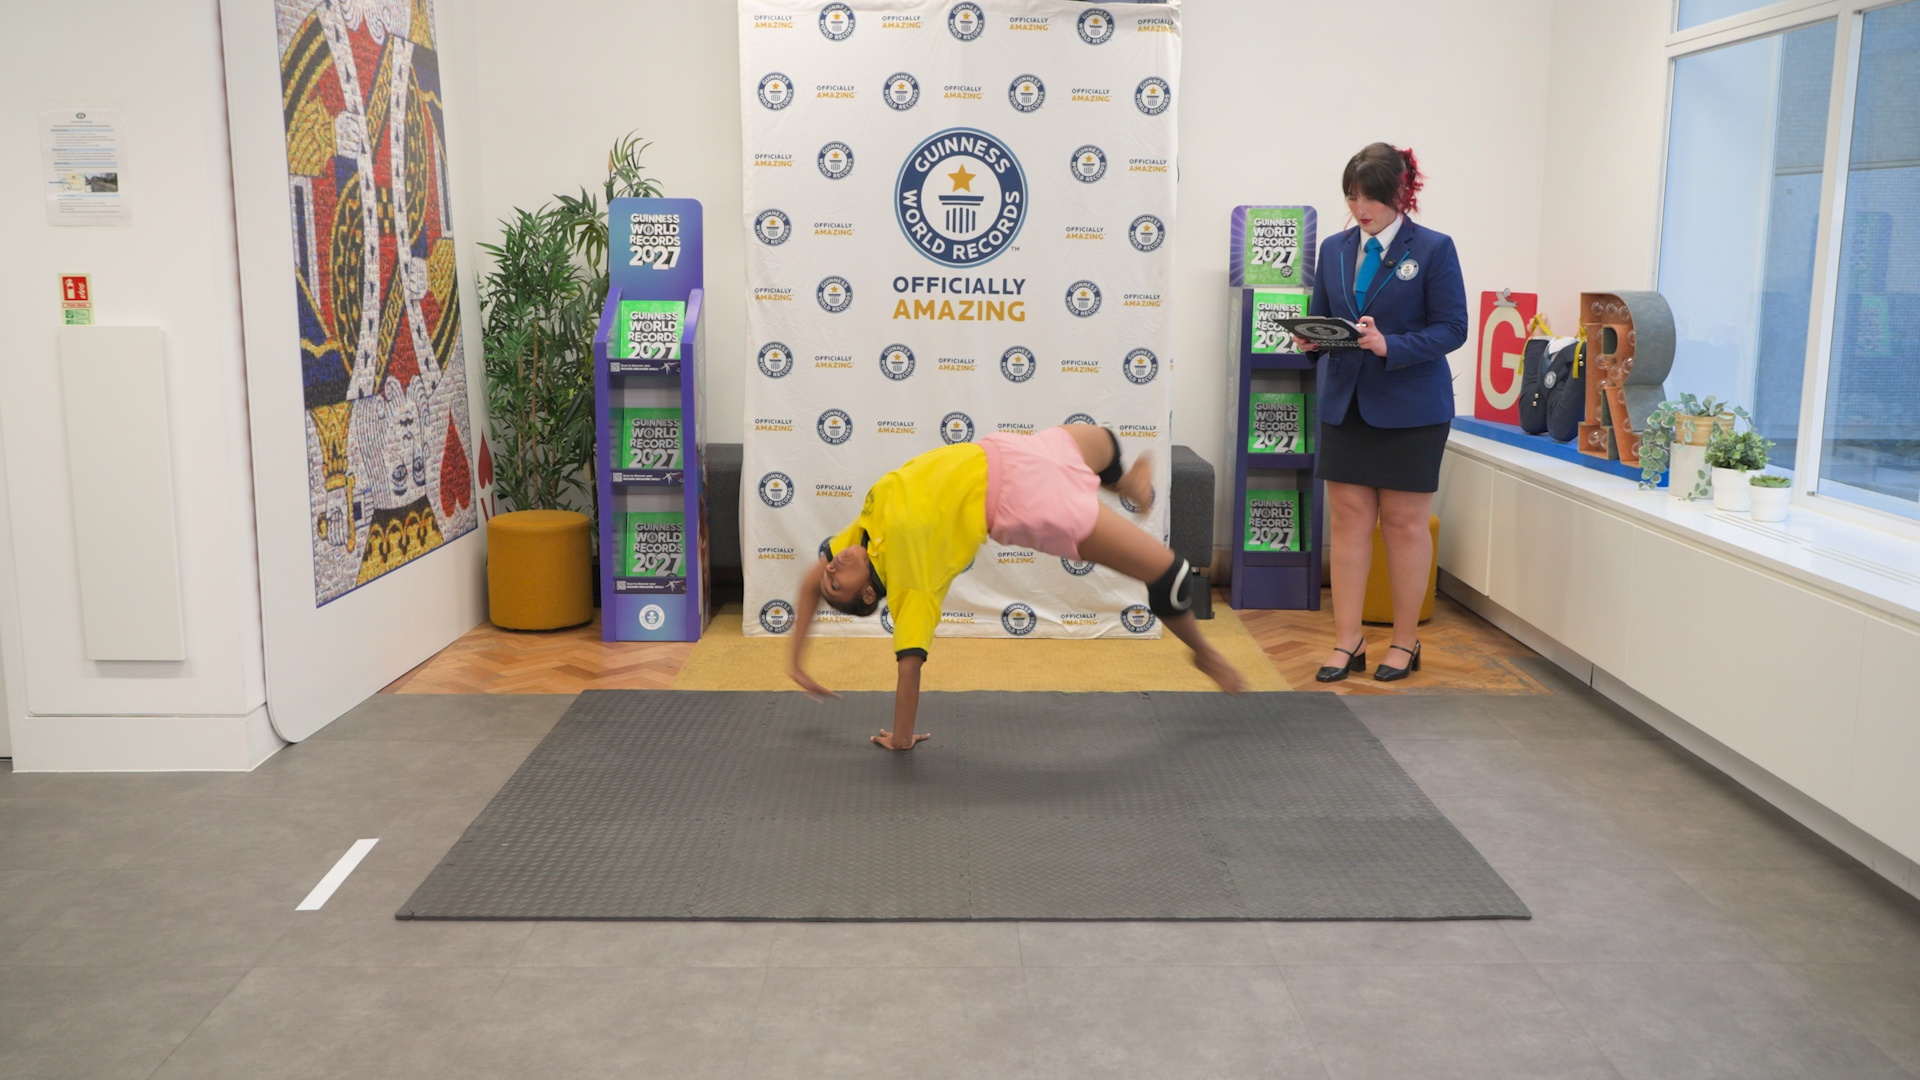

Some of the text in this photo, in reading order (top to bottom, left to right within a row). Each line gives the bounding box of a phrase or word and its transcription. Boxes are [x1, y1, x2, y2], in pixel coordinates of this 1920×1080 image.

[824, 5, 851, 15] GUINNESS
[953, 4, 980, 15] GUINNESS
[1082, 10, 1109, 20] GUINNESS
[754, 21, 792, 29] AMAZING
[821, 19, 853, 39] WORLD RECORDS
[882, 21, 920, 29] AMAZING
[950, 19, 982, 39] WORLD RECORDS
[1137, 25, 1174, 34] AMAZING
[1078, 24, 1112, 43] WORLD RECORDS
[763, 75, 789, 85] GUINNESS
[888, 75, 915, 85] GUINNESS
[1014, 76, 1041, 87] GUINNESS
[1140, 79, 1166, 89] GUINNESS
[759, 89, 792, 108] WORLD RECORDS
[885, 89, 918, 109] WORLD RECORDS
[944, 92, 981, 100] AMAZING
[1010, 91, 1043, 111] WORLD RECORDS
[1136, 94, 1169, 113] WORLD RECORDS
[823, 144, 849, 154] GUINNESS
[913, 135, 1012, 173] GUINNESS
[1076, 147, 1102, 158] GUINNESS
[754, 160, 792, 168] AMAZING
[819, 158, 852, 177] WORLD RECORDS
[1072, 162, 1105, 181] WORLD RECORDS
[631, 213, 679, 223] GUINNESS
[759, 211, 786, 221] GUINNESS
[901, 189, 1021, 260] WORLD RECORDS
[1134, 217, 1160, 227] GUINNESS
[1254, 218, 1297, 226] GUINNESS
[630, 224, 679, 235] WORLD
[756, 225, 789, 244] WORLD RECORDS
[1253, 227, 1296, 237] WORLD
[629, 235, 680, 245] RECORDS
[1130, 231, 1163, 250] WORLD RECORDS
[1252, 238, 1297, 246] RECORDS
[629, 246, 681, 270] 2027
[1251, 247, 1297, 268] 2027
[822, 278, 848, 288] GUINNESS
[893, 276, 1026, 295] OFFICIALLY
[1070, 282, 1097, 292] GUINNESS
[754, 293, 791, 301] AMAZING
[818, 292, 851, 311] WORLD RECORDS
[892, 299, 1026, 322] AMAZING
[1067, 297, 1100, 316] WORLD RECORDS
[1257, 303, 1301, 311] GUINNESS
[630, 312, 678, 321] GUINNESS
[629, 321, 677, 332] WORLD
[628, 332, 678, 342] RECORDS
[628, 342, 679, 359] 2027
[762, 344, 789, 354] GUINNESS
[885, 346, 911, 356] GUINNESS
[1005, 348, 1031, 358] GUINNESS
[1128, 350, 1154, 360] GUINNESS
[759, 358, 791, 377] WORLD RECORDS
[881, 360, 914, 379] WORLD RECORDS
[1002, 362, 1034, 381] WORLD RECORDS
[1125, 364, 1157, 383] WORLD RECORDS
[1578, 290, 1674, 468] R
[1255, 403, 1298, 411] GUINNESS
[822, 411, 848, 421] GUINNESS
[1254, 412, 1297, 421] WORLD
[632, 418, 680, 427] GUINNESS
[1253, 421, 1298, 431] RECORDS
[632, 427, 678, 438] WORLD
[818, 425, 851, 443] WORLD RECORDS
[877, 427, 914, 435] AMAZING
[630, 439, 680, 449] RECORDS
[1253, 432, 1298, 453] 2027
[629, 449, 680, 469] 2027
[763, 474, 790, 483] GUINNESS
[760, 488, 792, 506] WORLD RECORDS
[815, 491, 852, 499] AMAZING
[1250, 500, 1293, 508] GUINNESS
[1250, 508, 1293, 518] WORLD
[636, 523, 682, 531] GUINNESS
[1249, 518, 1294, 528] RECORDS
[636, 532, 682, 543] WORLD
[1249, 528, 1294, 548] 2027
[634, 543, 682, 553] RECORDS
[757, 553, 794, 561] AMAZING
[997, 557, 1034, 565] AMAZING
[633, 554, 682, 576] 2027
[764, 601, 790, 610] GUINNESS
[1007, 605, 1032, 614] GUINNESS
[761, 614, 773, 630] WORLD
[1004, 617, 1035, 634] WORLD RECORDS
